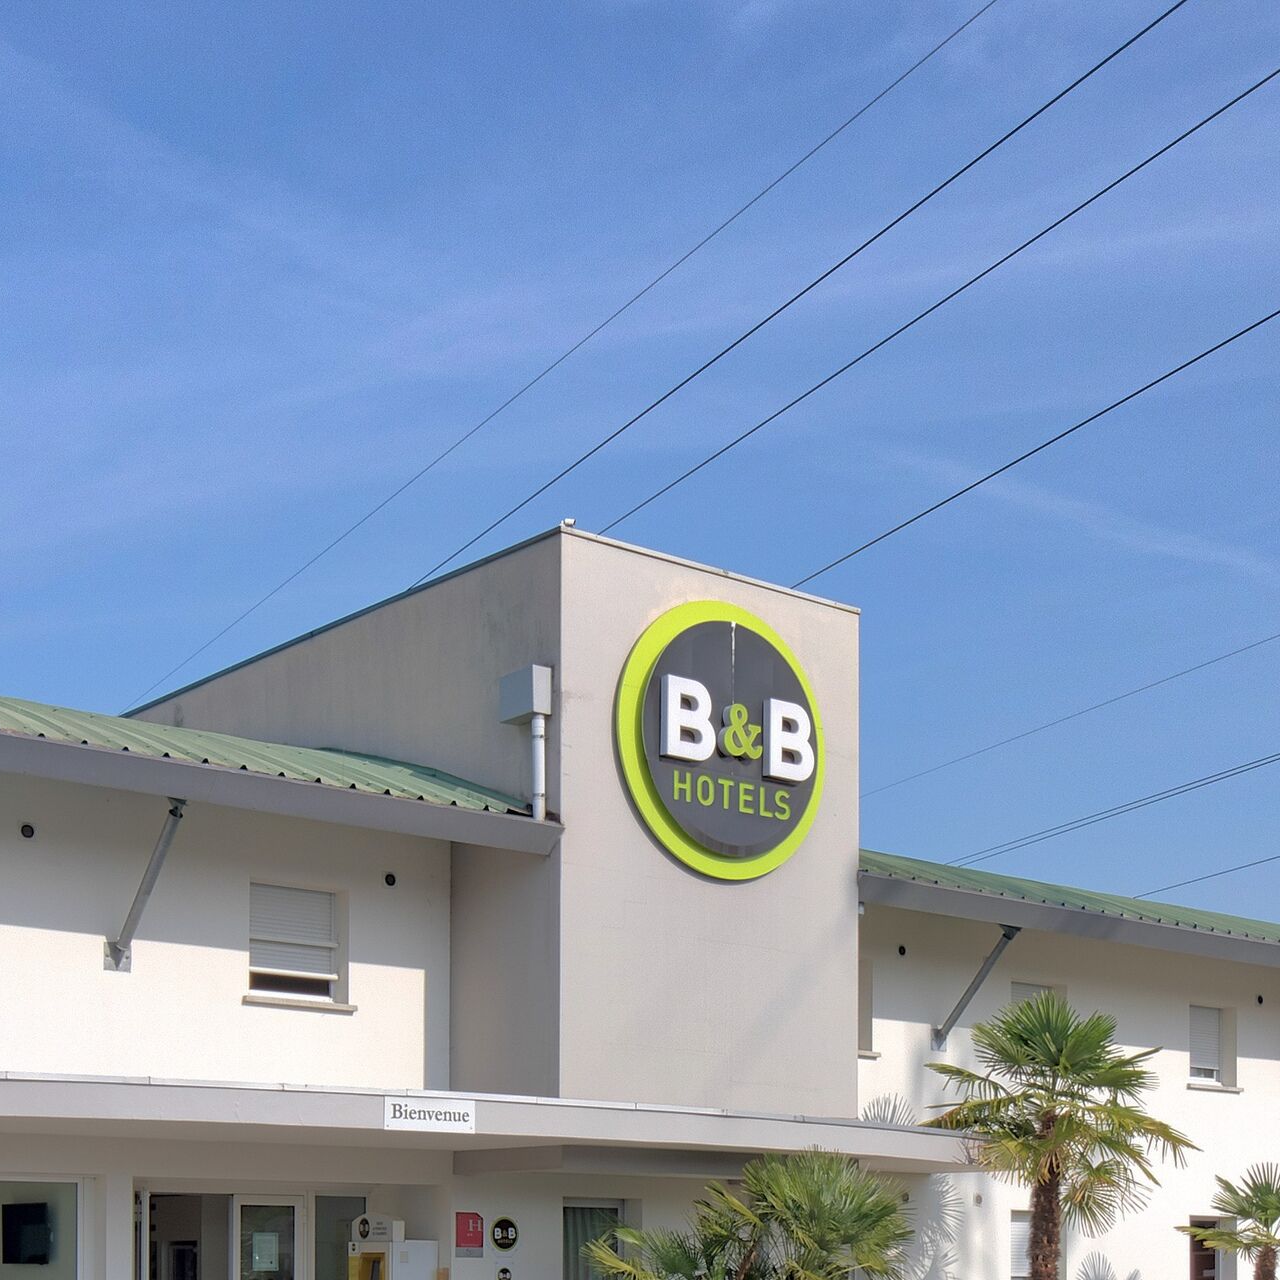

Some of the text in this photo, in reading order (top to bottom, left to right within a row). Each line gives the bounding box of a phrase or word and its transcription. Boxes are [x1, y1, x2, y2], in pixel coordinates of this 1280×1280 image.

[660, 674, 815, 783] B&B
[673, 769, 791, 821] HOTELS
[391, 1103, 470, 1122] Bienvenue
